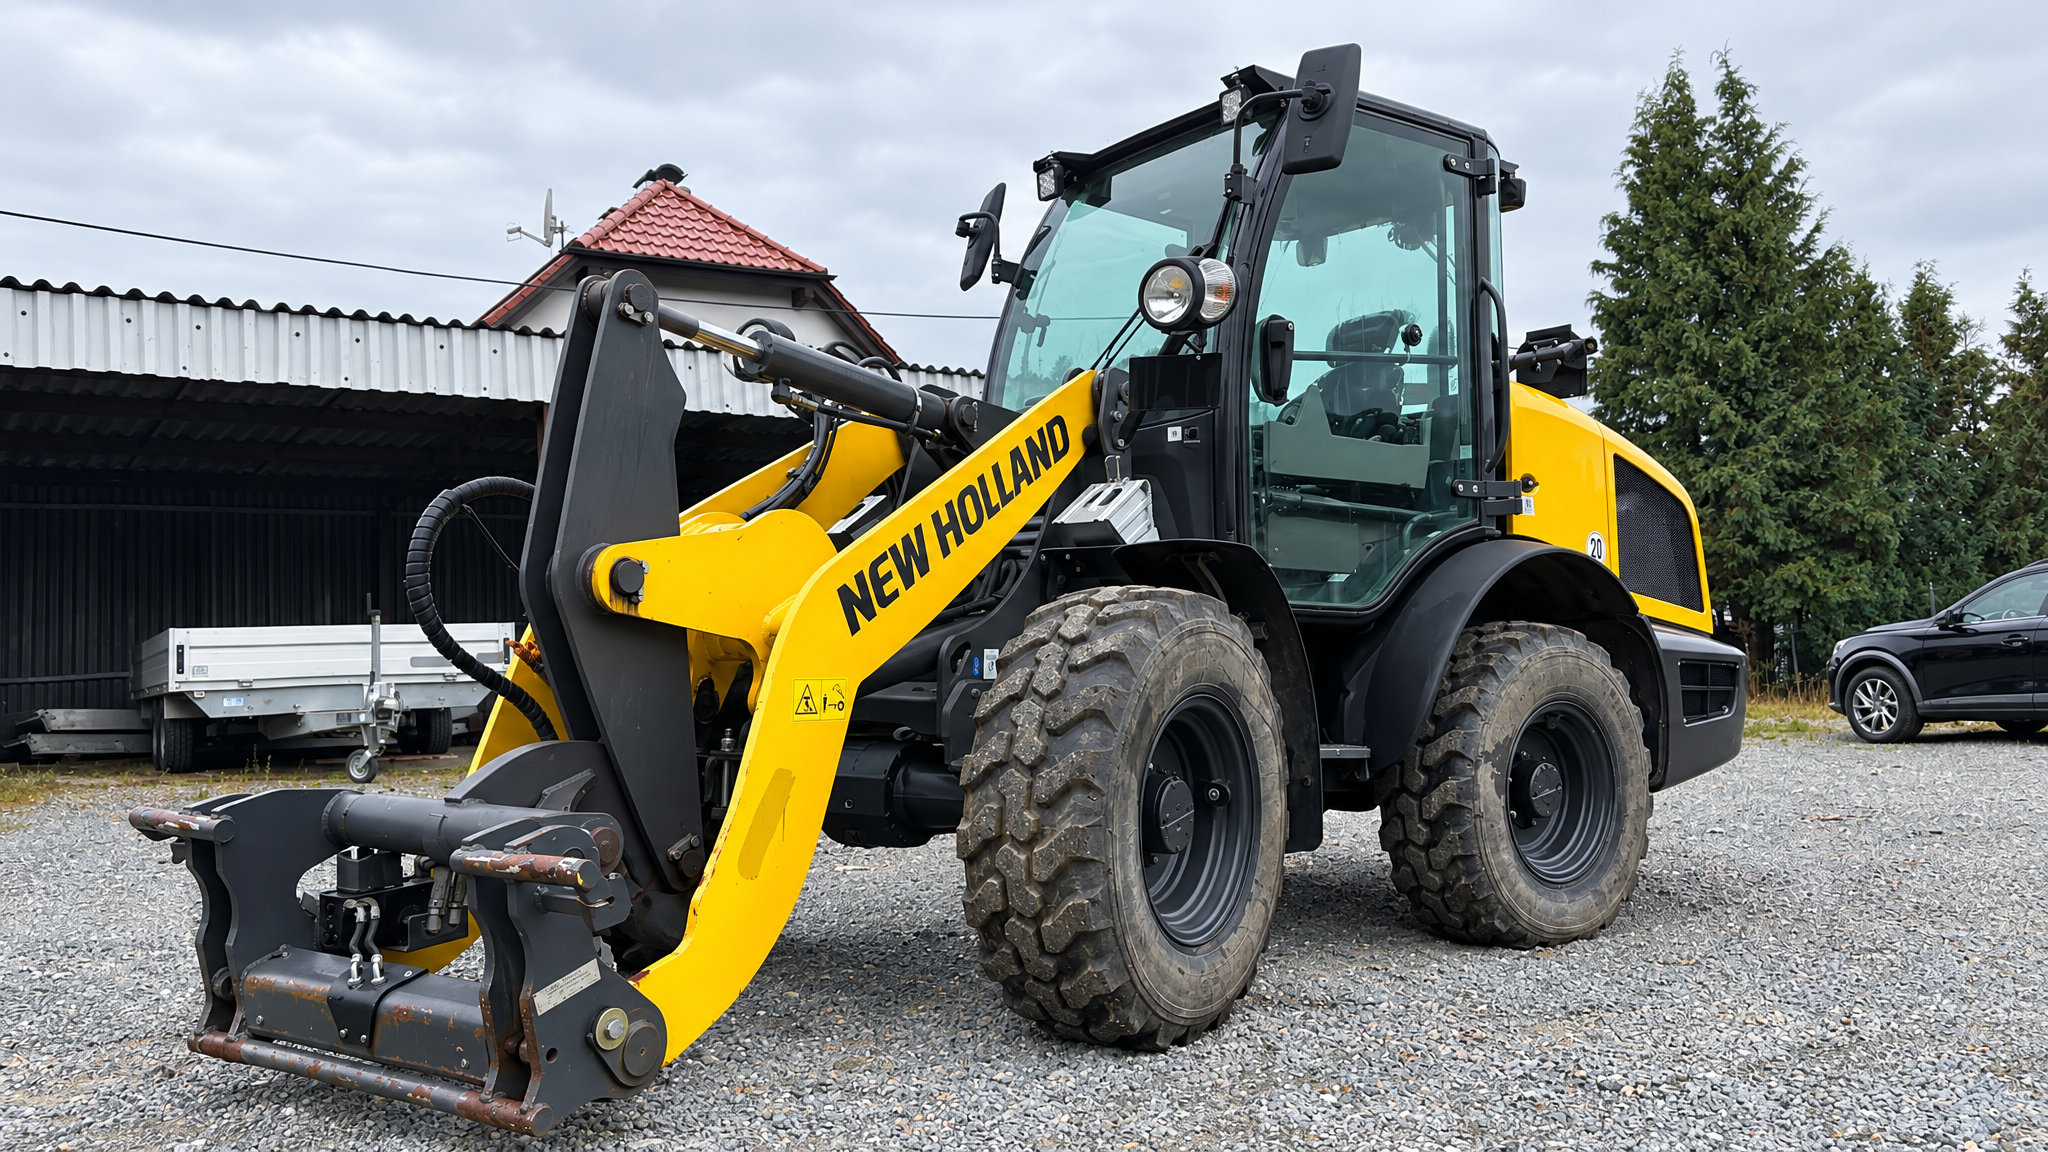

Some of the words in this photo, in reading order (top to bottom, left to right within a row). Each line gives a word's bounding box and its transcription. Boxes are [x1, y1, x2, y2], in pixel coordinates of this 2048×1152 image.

[836, 523, 930, 637] NEW
[930, 415, 1070, 560] HOLLAND
[1590, 537, 1603, 560] 20
